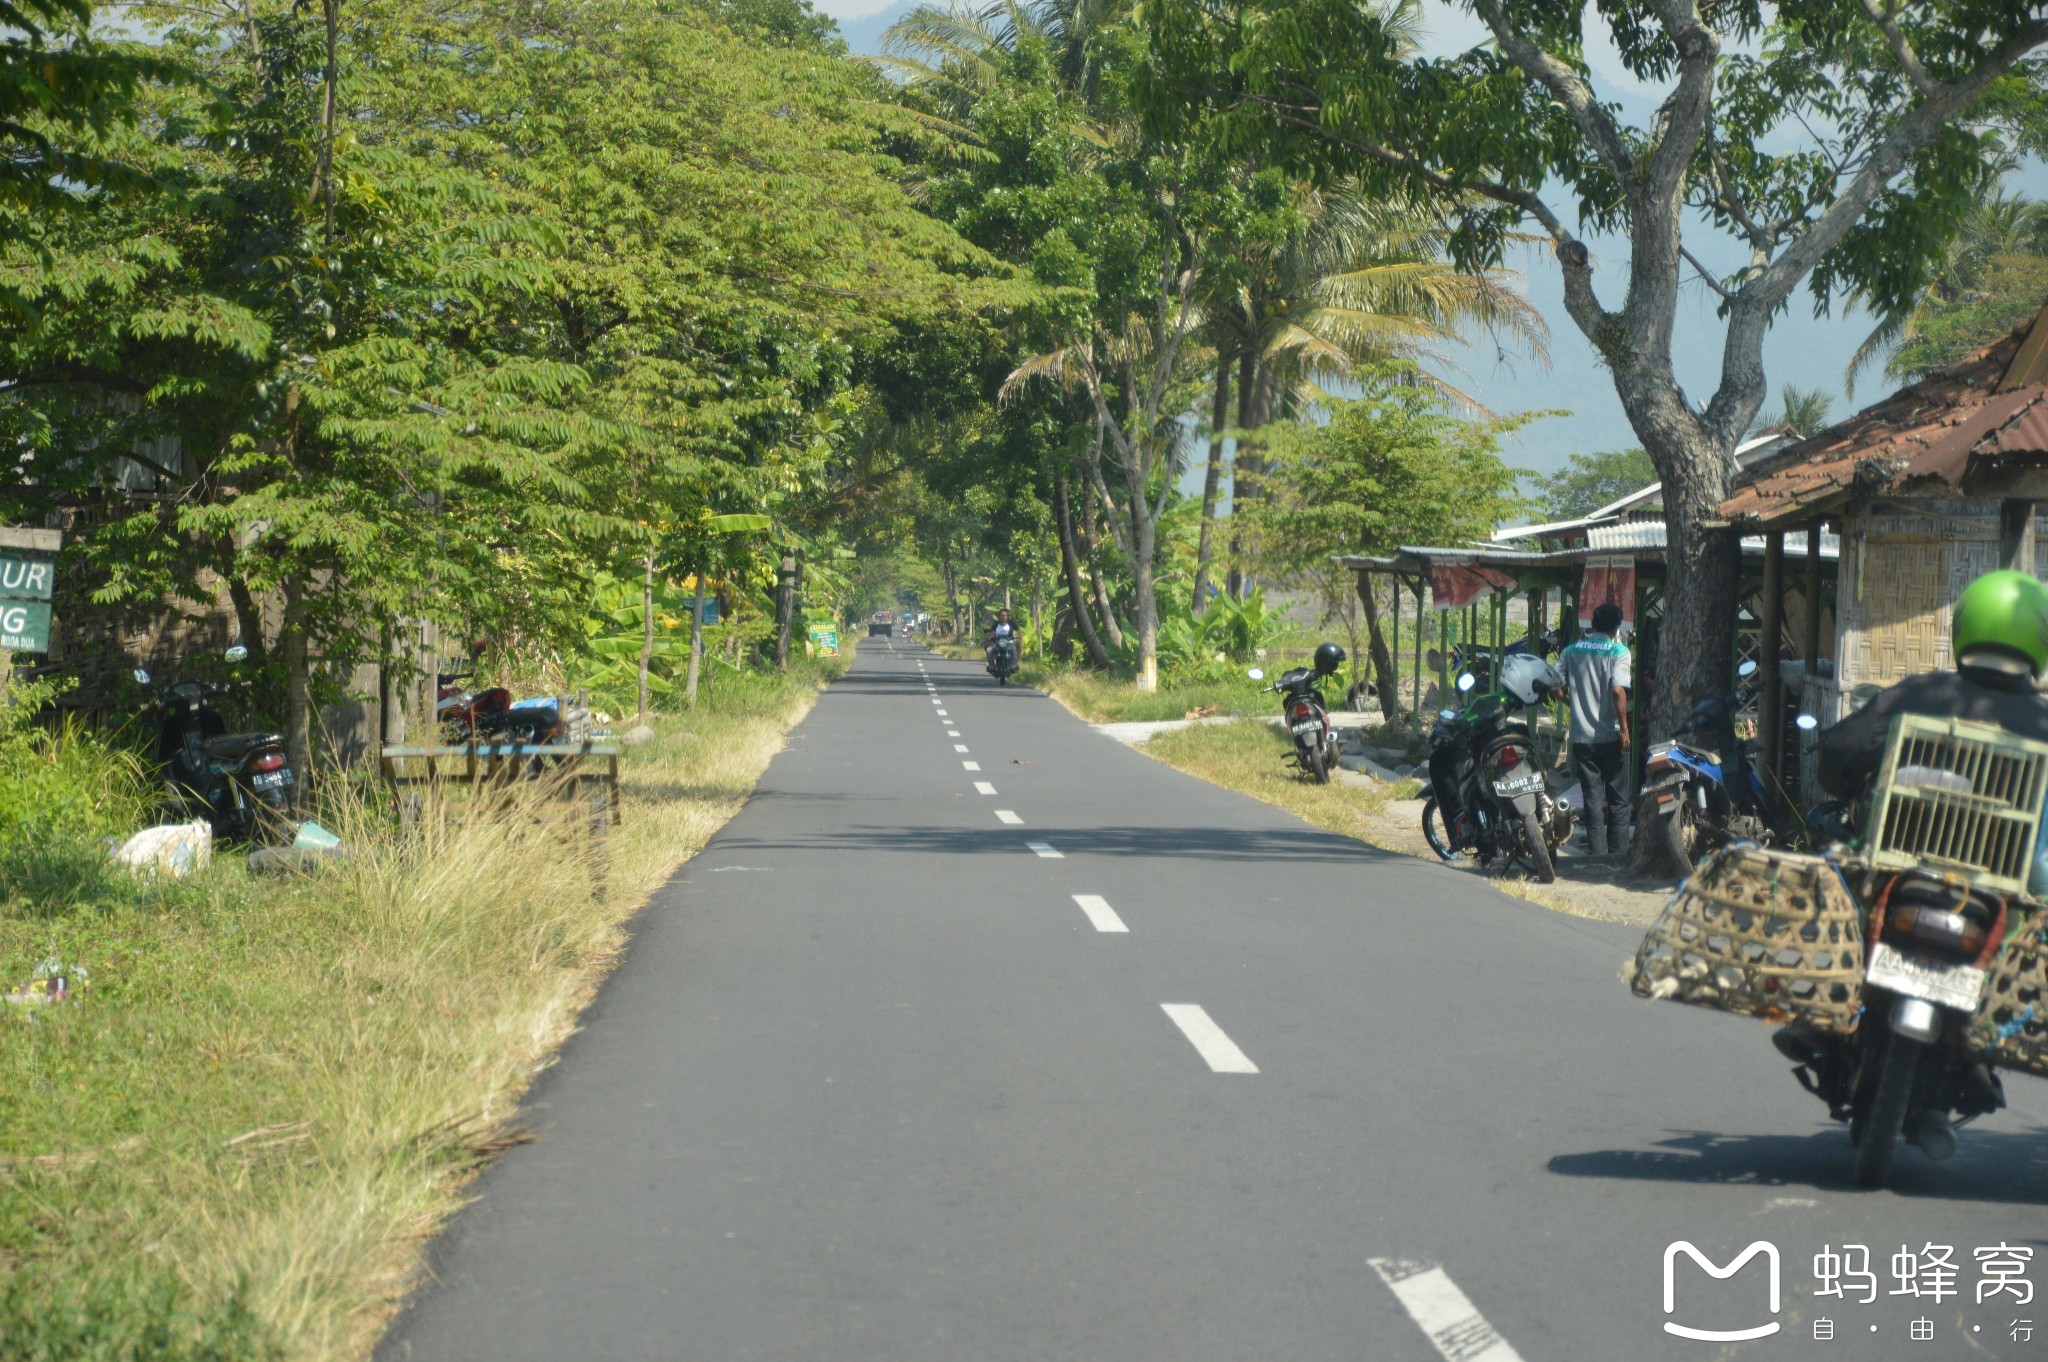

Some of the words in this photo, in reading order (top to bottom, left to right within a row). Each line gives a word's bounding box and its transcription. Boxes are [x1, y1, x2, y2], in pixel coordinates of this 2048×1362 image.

[0, 562, 46, 590] UR
[21, 636, 35, 649] DUA
[1575, 641, 1612, 651] PETRONAS
